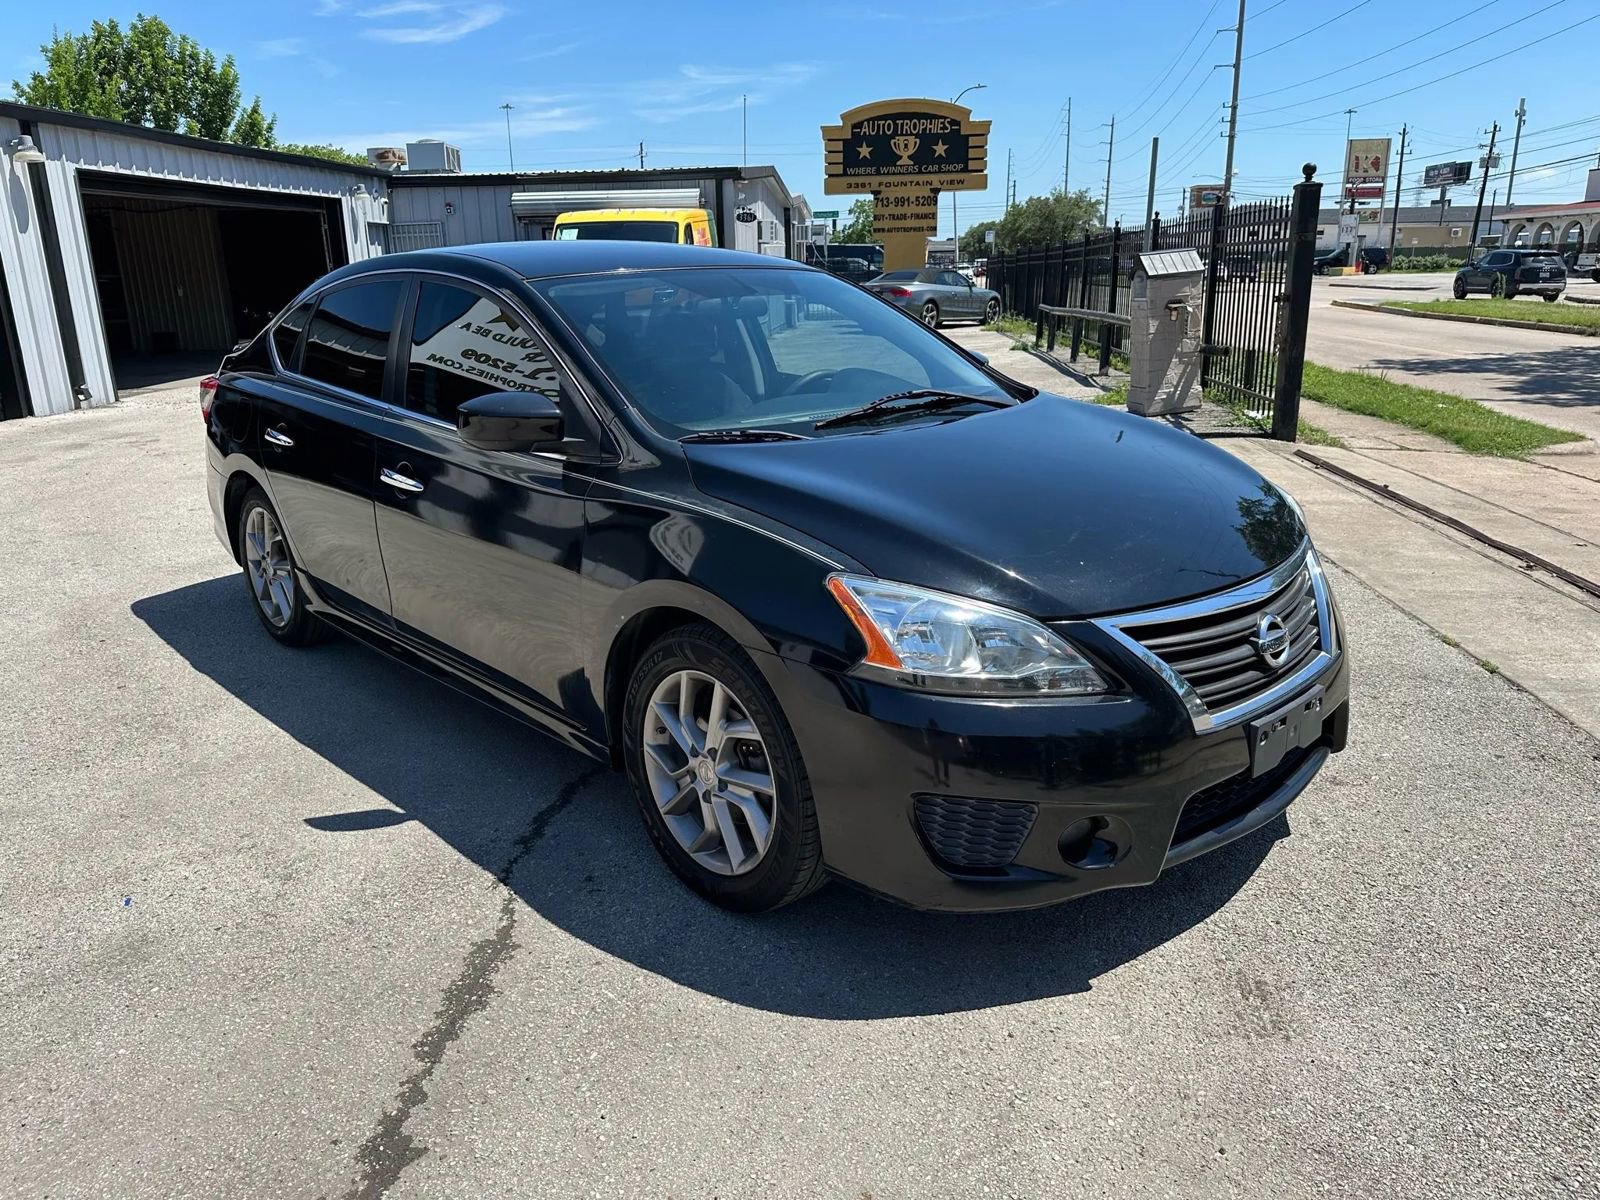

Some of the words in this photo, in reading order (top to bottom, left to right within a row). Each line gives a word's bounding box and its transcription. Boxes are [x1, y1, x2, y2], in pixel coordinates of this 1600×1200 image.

[860, 120, 894, 136] AUTO
[896, 118, 951, 135] TROPHIES
[846, 166, 877, 175] WHERE
[880, 165, 919, 174] WINNERS
[921, 164, 939, 173] CAR
[941, 163, 964, 172] SHOP
[878, 180, 933, 188] FOUNTAIN
[939, 178, 966, 186] VIEW
